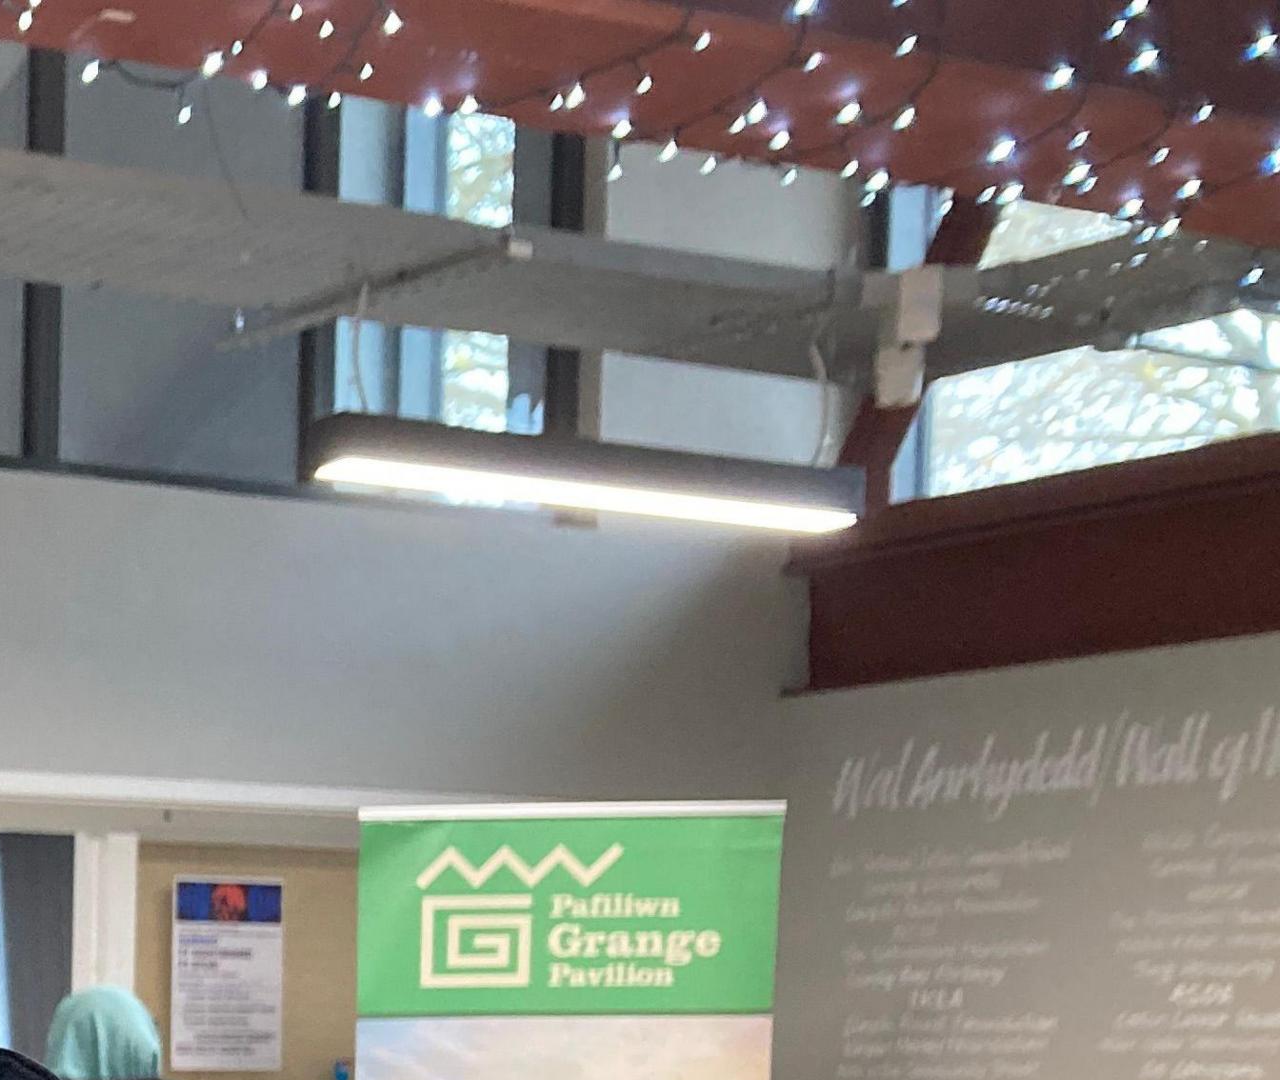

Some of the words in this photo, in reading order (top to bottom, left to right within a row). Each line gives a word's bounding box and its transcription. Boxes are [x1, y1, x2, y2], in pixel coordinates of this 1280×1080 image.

[549, 892, 680, 918] Pafiliwn
[548, 922, 722, 966] Grange
[548, 962, 673, 988] Pavilion
